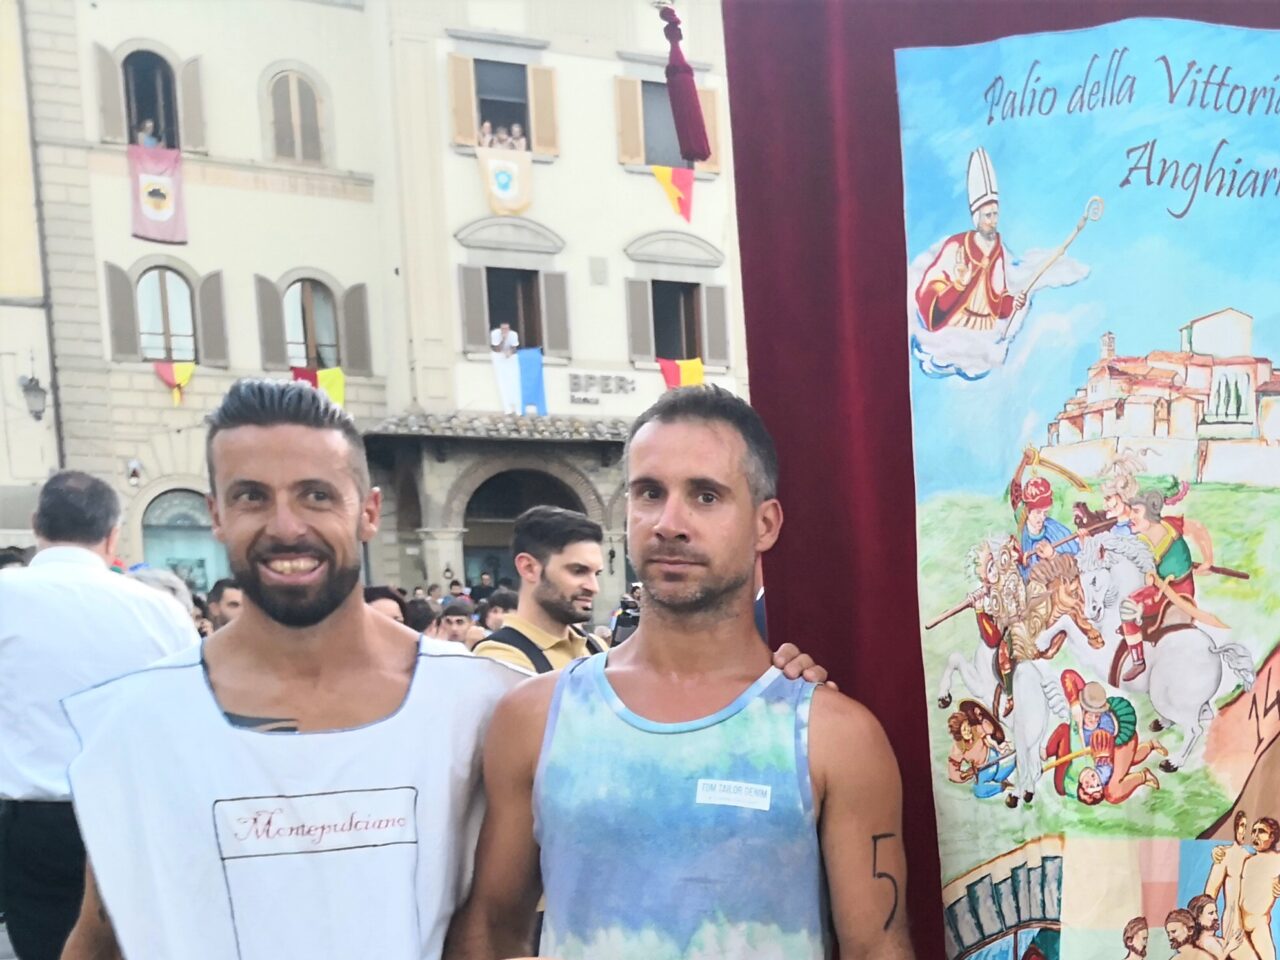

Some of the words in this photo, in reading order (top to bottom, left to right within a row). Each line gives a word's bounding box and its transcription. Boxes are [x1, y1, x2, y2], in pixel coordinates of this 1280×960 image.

[984, 59, 1058, 126] Palio
[1067, 46, 1138, 115] della
[871, 832, 899, 932] 5
